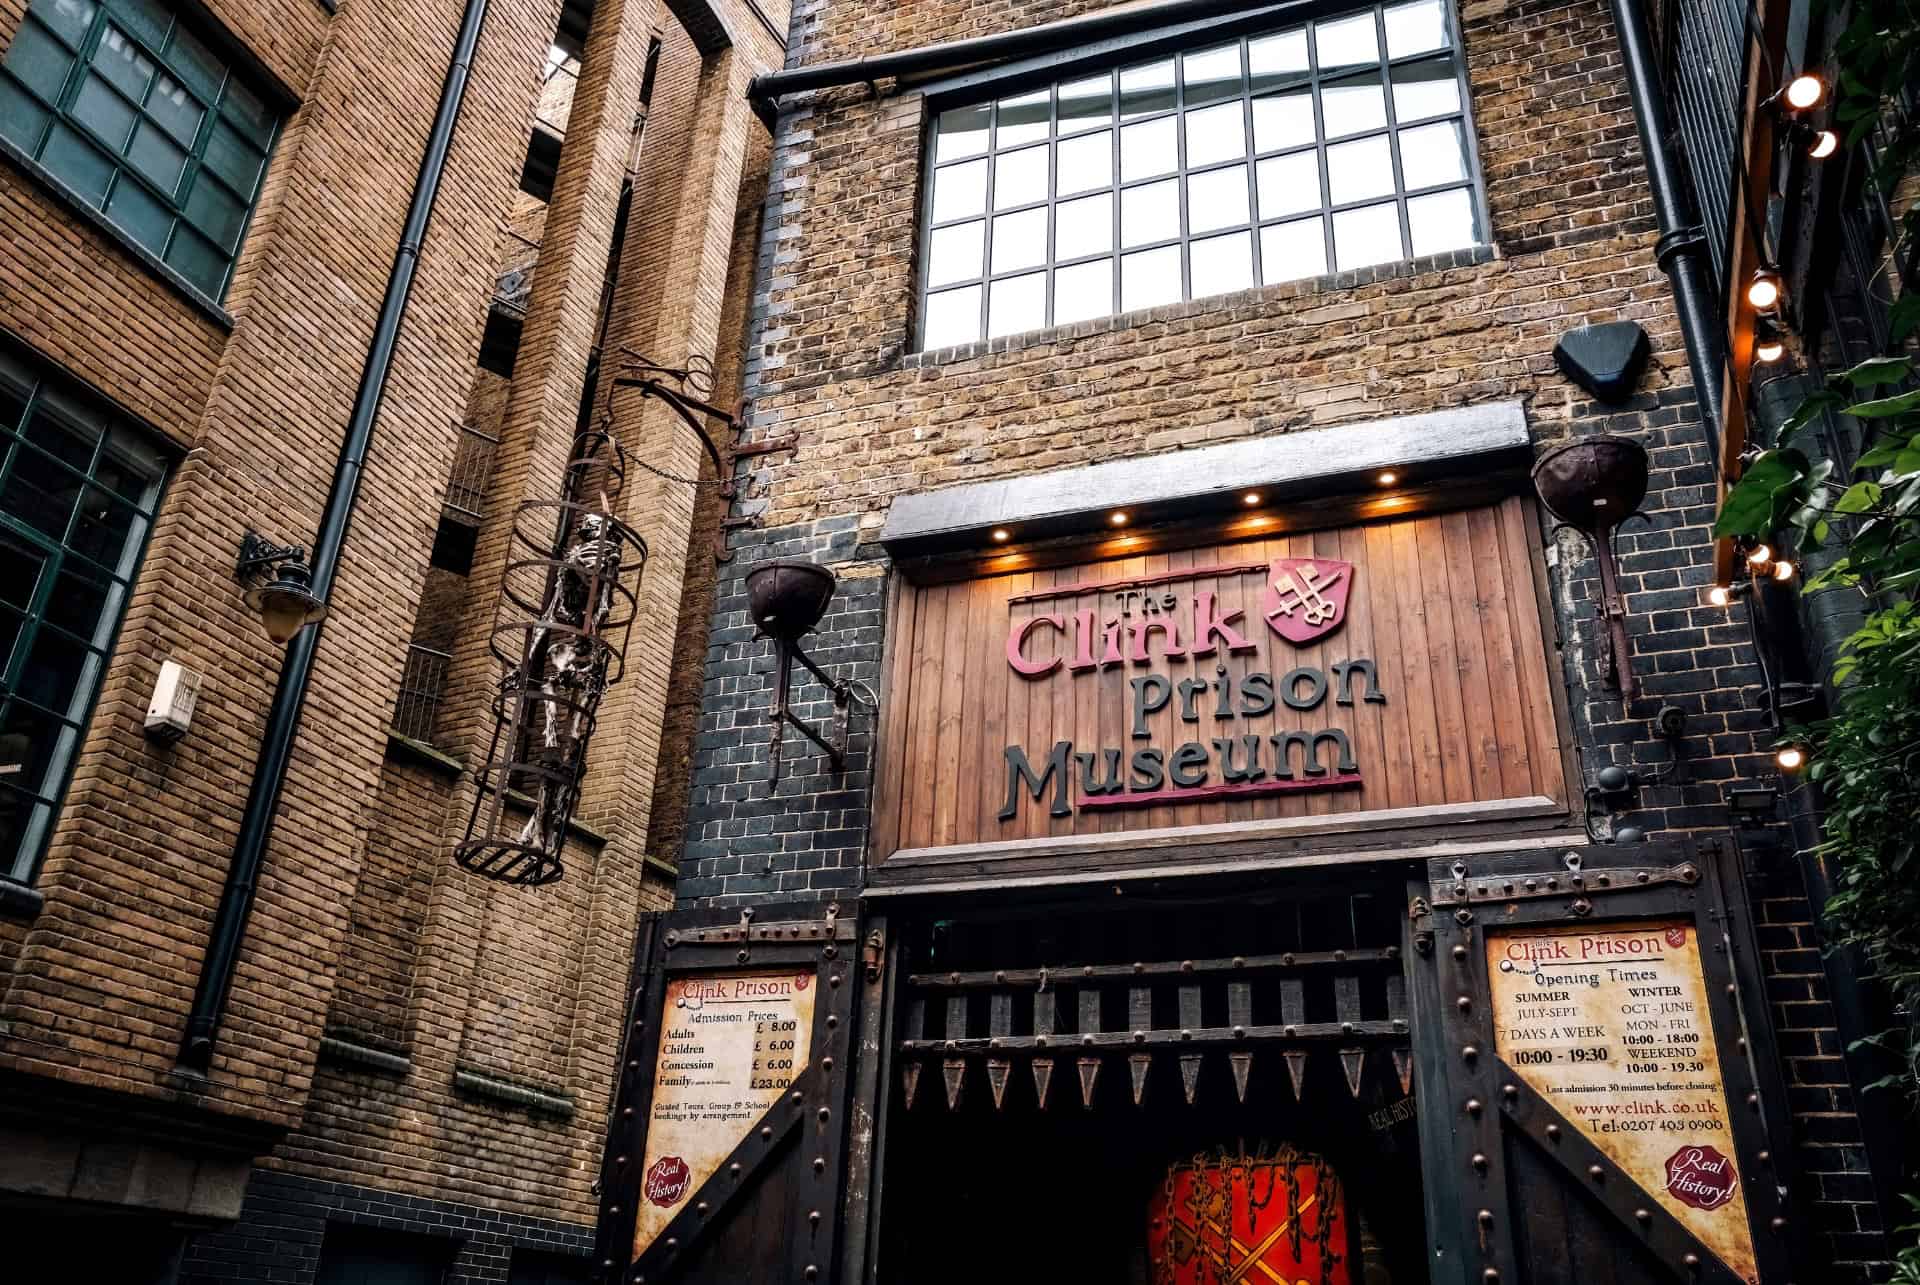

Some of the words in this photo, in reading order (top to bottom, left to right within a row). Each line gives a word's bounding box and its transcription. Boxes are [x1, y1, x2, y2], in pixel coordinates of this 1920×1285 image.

[1116, 590, 1176, 617] The
[1007, 592, 1257, 679] Clink
[999, 728, 1360, 820] Museum
[1507, 940, 1570, 961] Clink
[1580, 936, 1663, 959] Prison
[1535, 972, 1600, 988] Opening
[1606, 968, 1657, 982] Times
[683, 982, 727, 998] Clink
[735, 981, 791, 998] Prison
[1628, 986, 1682, 998] WINTER
[1515, 991, 1570, 1003] SUMMER
[1517, 1007, 1578, 1021] JULY-SEPT
[1621, 1003, 1650, 1015] OCT
[1659, 1001, 1694, 1014] JUNE
[688, 1012, 742, 1024] Admission
[749, 1010, 778, 1021] Prices
[771, 1021, 796, 1031] 8.00
[1626, 1019, 1658, 1031] MON
[1669, 1018, 1690, 1030] FRI
[664, 1029, 695, 1039] Adults
[1499, 1030, 1505, 1041] 7
[1511, 1028, 1547, 1041] DAYS
[1551, 1028, 1560, 1039] A
[1562, 1026, 1606, 1038] WEEK
[1622, 1034, 1654, 1045] 10:00
[1667, 1033, 1699, 1044] 18:00
[663, 1044, 704, 1055] Children
[769, 1040, 794, 1050] 6.00
[1514, 1051, 1552, 1065] 10:00
[1569, 1048, 1608, 1062] 19:30
[1628, 1047, 1697, 1059] WEEKEND
[660, 1060, 714, 1071] Concession
[767, 1060, 792, 1070] 6.00
[1626, 1063, 1658, 1074] 10:00
[659, 1076, 692, 1089] Family
[1608, 1084, 1619, 1092] 30
[745, 1101, 770, 1110] School
[1574, 1099, 1719, 1116] www.clink.co.uk
[690, 1111, 699, 1121] by
[1688, 1119, 1723, 1130] 0900
[1672, 1148, 1727, 1175] Real
[651, 1159, 680, 1179] Real
[648, 1174, 689, 1201] History!
[1662, 1167, 1737, 1205] History!
